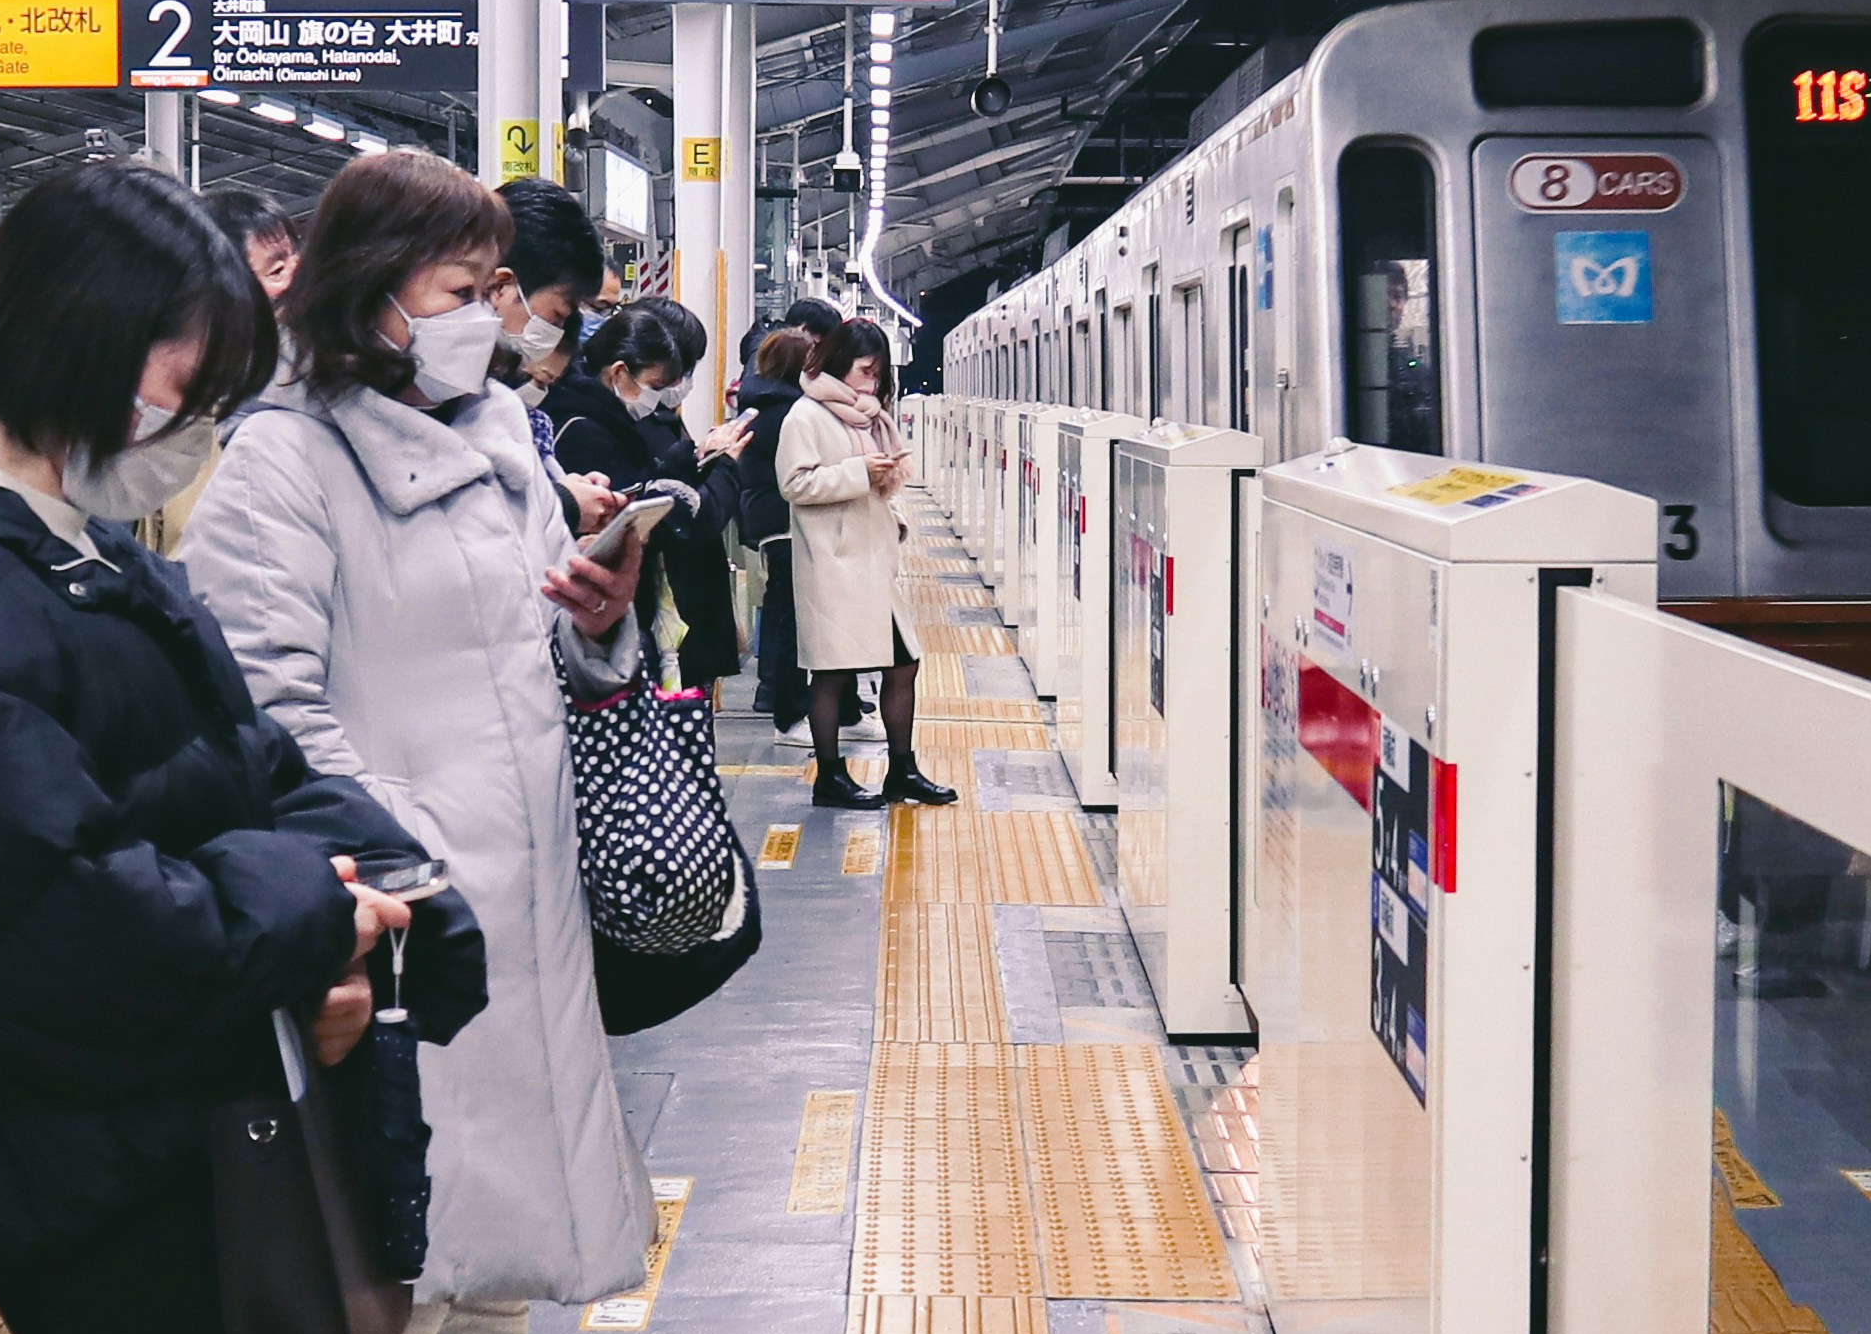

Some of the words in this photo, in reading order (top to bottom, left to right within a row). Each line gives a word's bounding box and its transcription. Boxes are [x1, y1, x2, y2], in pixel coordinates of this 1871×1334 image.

[213, 0, 265, 13] 大井町線
[148, 0, 192, 67] 2
[212, 20, 289, 46] 大岡山
[298, 20, 375, 46] 旗の台
[385, 20, 463, 46] 大井町
[466, 31, 479, 46] 方
[213, 48, 233, 64] for
[237, 47, 318, 67] Ōokayama,
[322, 49, 401, 66] Hatanodai,
[212, 66, 274, 82] Ōimachi
[331, 68, 361, 83] Line)
[693, 143, 710, 165] E
[1541, 164, 1570, 201] 8
[1597, 171, 1675, 196] CARS
[1663, 504, 1699, 561] 3
